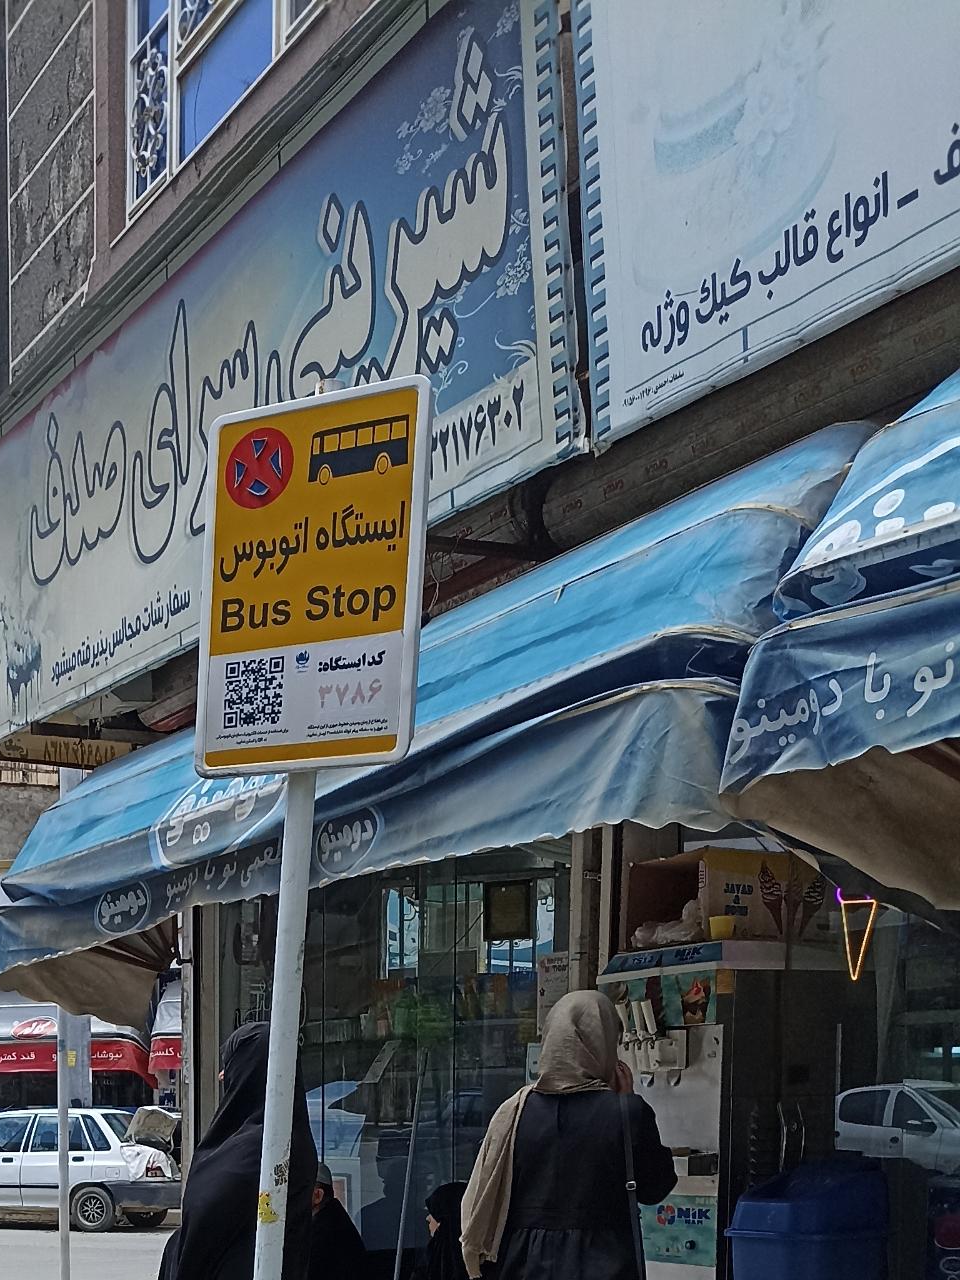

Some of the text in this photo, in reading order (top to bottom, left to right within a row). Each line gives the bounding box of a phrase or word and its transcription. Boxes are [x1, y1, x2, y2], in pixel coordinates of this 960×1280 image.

[826, 170, 889, 264] انواع
[757, 207, 820, 300] قالب
[219, 500, 406, 583] ایستگاه اتوبوس
[142, 584, 191, 630] سفارشات
[220, 584, 397, 633] Bus Stop
[108, 616, 141, 659] مجالس
[366, 650, 387, 667] کد
[318, 678, 383, 709] ۳۷۸۶
[729, 640, 955, 765] نو با دومینو
[320, 819, 374, 863] دومینو
[165, 865, 199, 909] دومینو
[204, 859, 216, 891] با
[100, 889, 147, 926] دومینو
